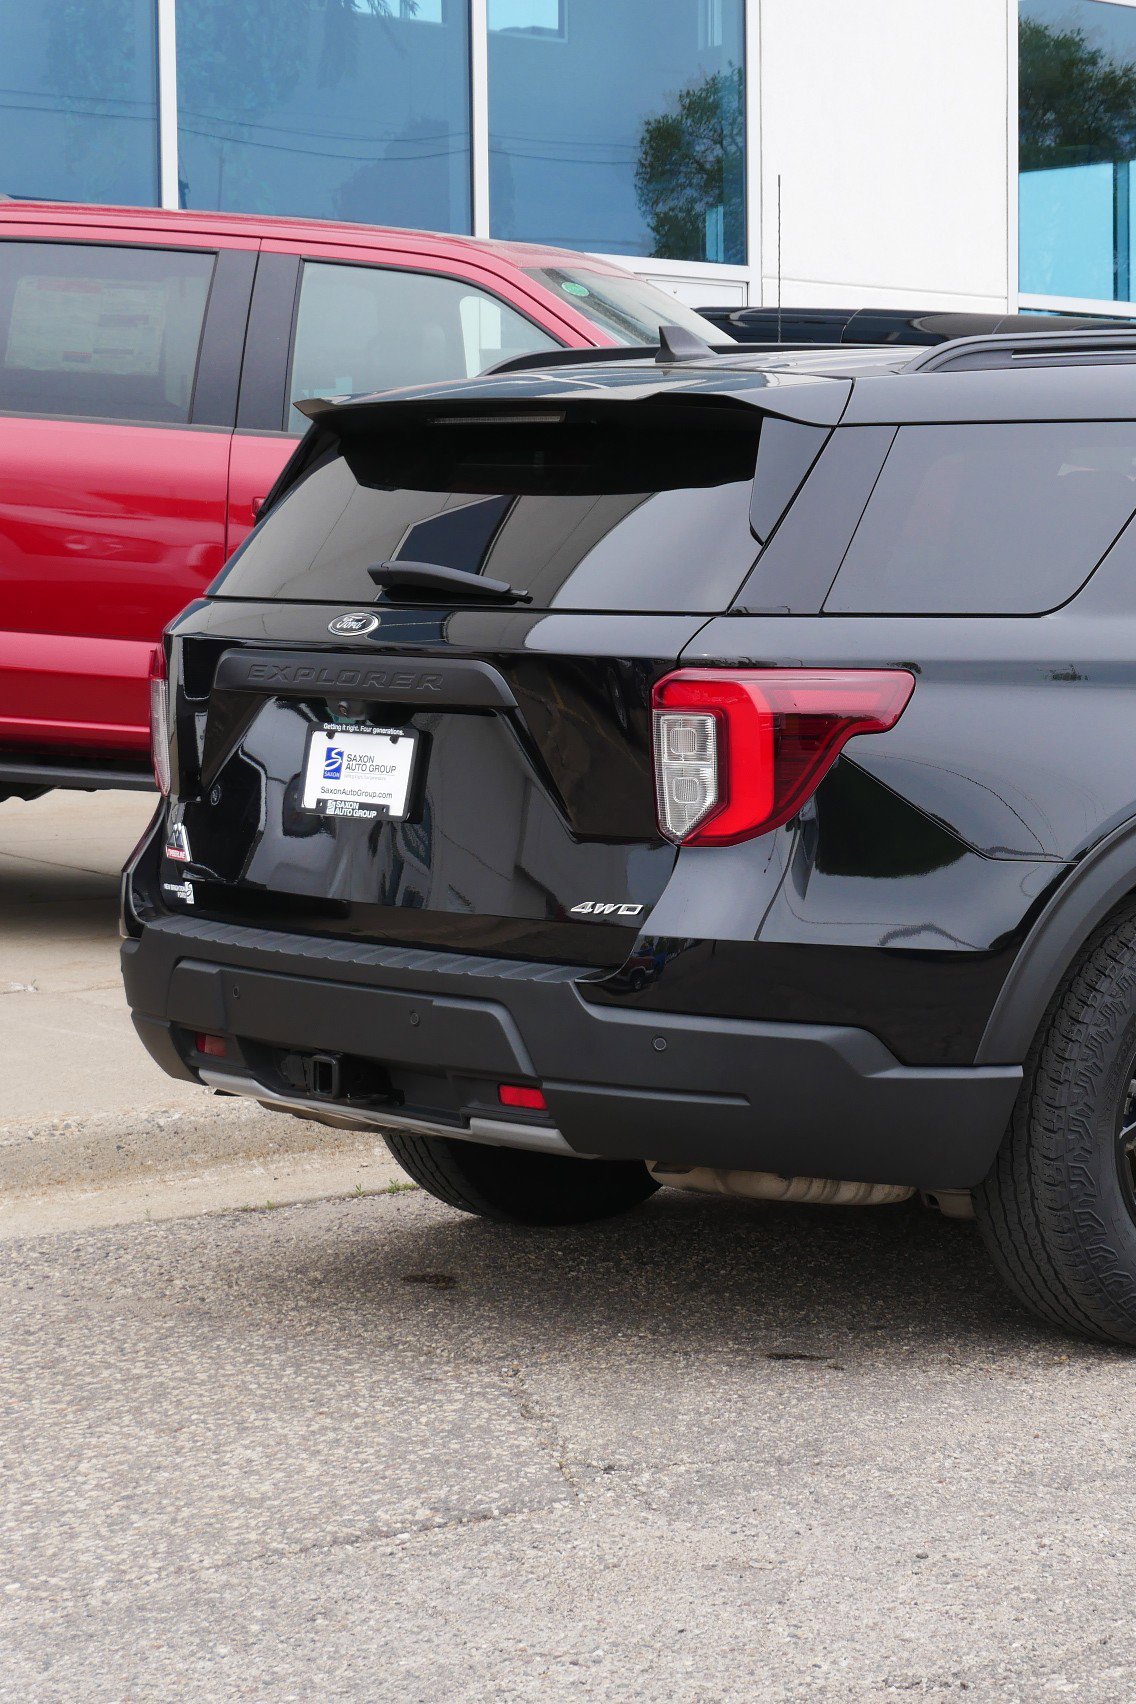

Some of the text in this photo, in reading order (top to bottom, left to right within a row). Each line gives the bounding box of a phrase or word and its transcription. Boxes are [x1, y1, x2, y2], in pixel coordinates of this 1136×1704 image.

[248, 663, 444, 691] EXPLORER
[323, 722, 341, 731] Getting
[346, 724, 360, 732] right.
[360, 725, 373, 733] Four
[372, 726, 405, 736] generations.
[346, 753, 375, 764] SAXON
[324, 770, 340, 778] SAXON
[345, 763, 397, 774] AUTO GROUP
[320, 785, 393, 800] SaxonAutoGroup.com
[335, 800, 360, 810] SAXON
[334, 808, 378, 819] AUTO GROUP
[570, 901, 644, 915] 4WD
